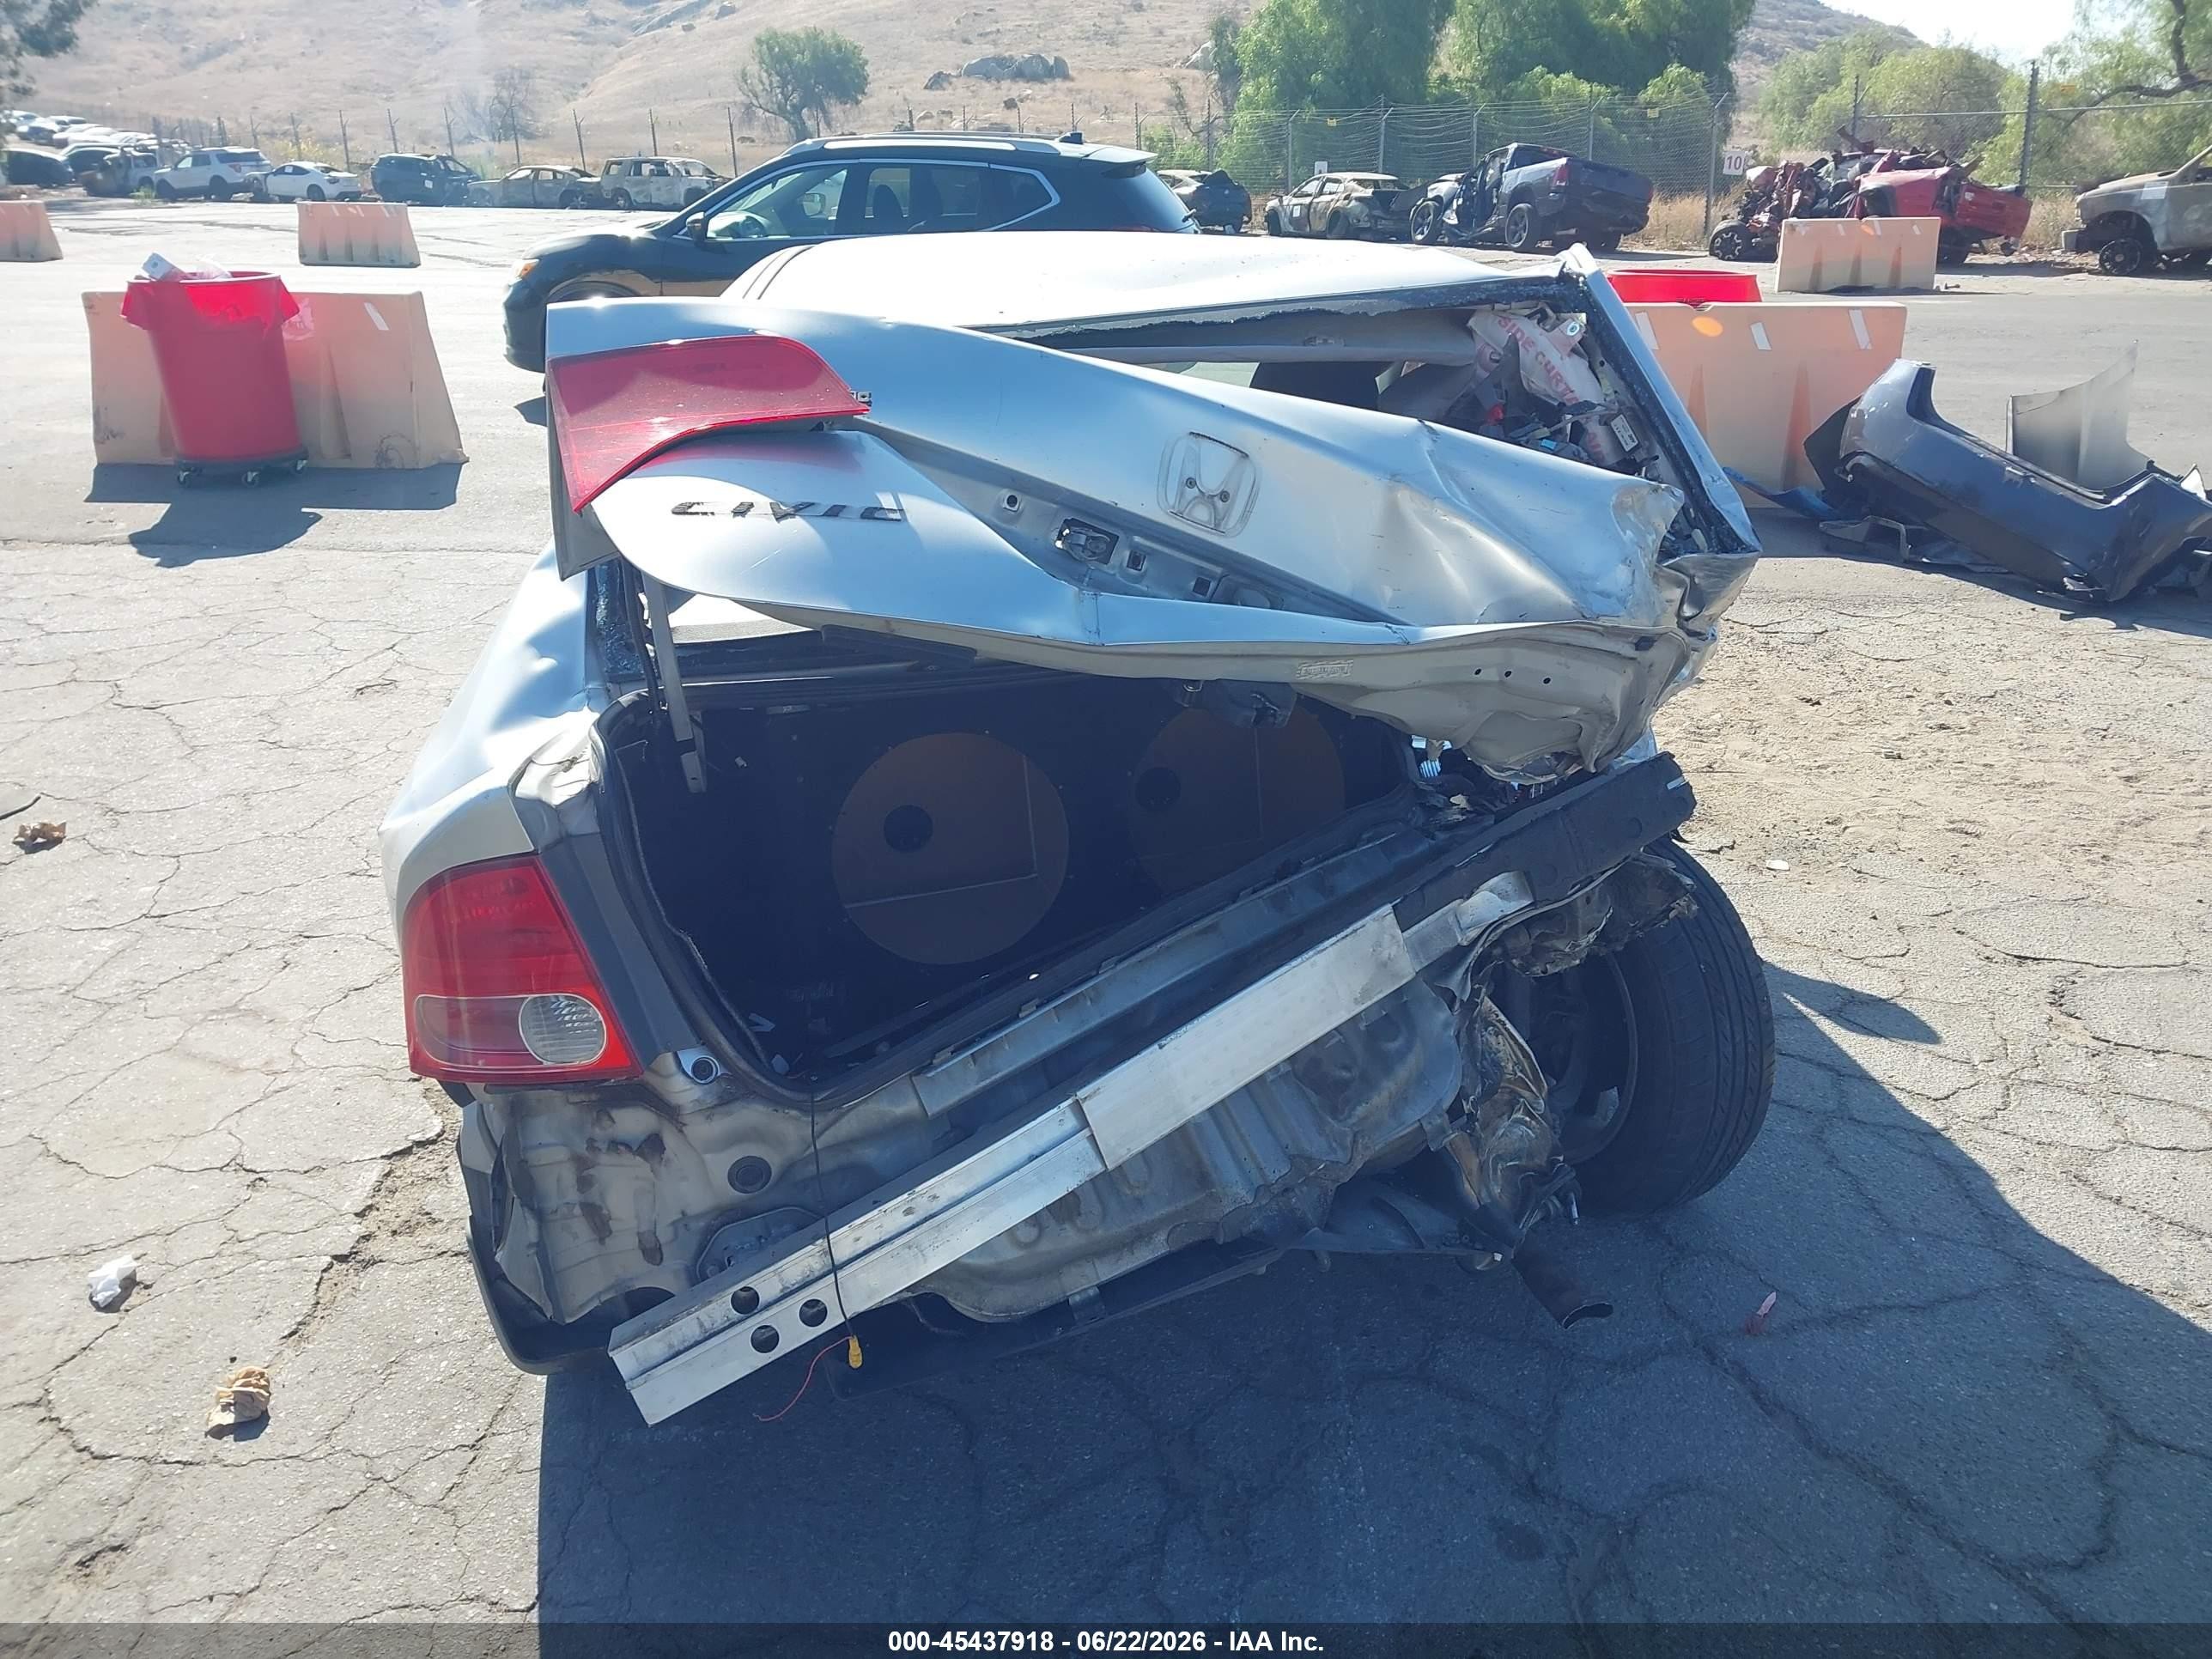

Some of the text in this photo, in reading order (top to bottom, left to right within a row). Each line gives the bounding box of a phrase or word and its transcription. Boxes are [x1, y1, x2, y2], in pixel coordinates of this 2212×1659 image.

[1727, 155, 1742, 170] 10
[1498, 317, 1536, 352] SIDE
[671, 501, 904, 524] CIVIC
